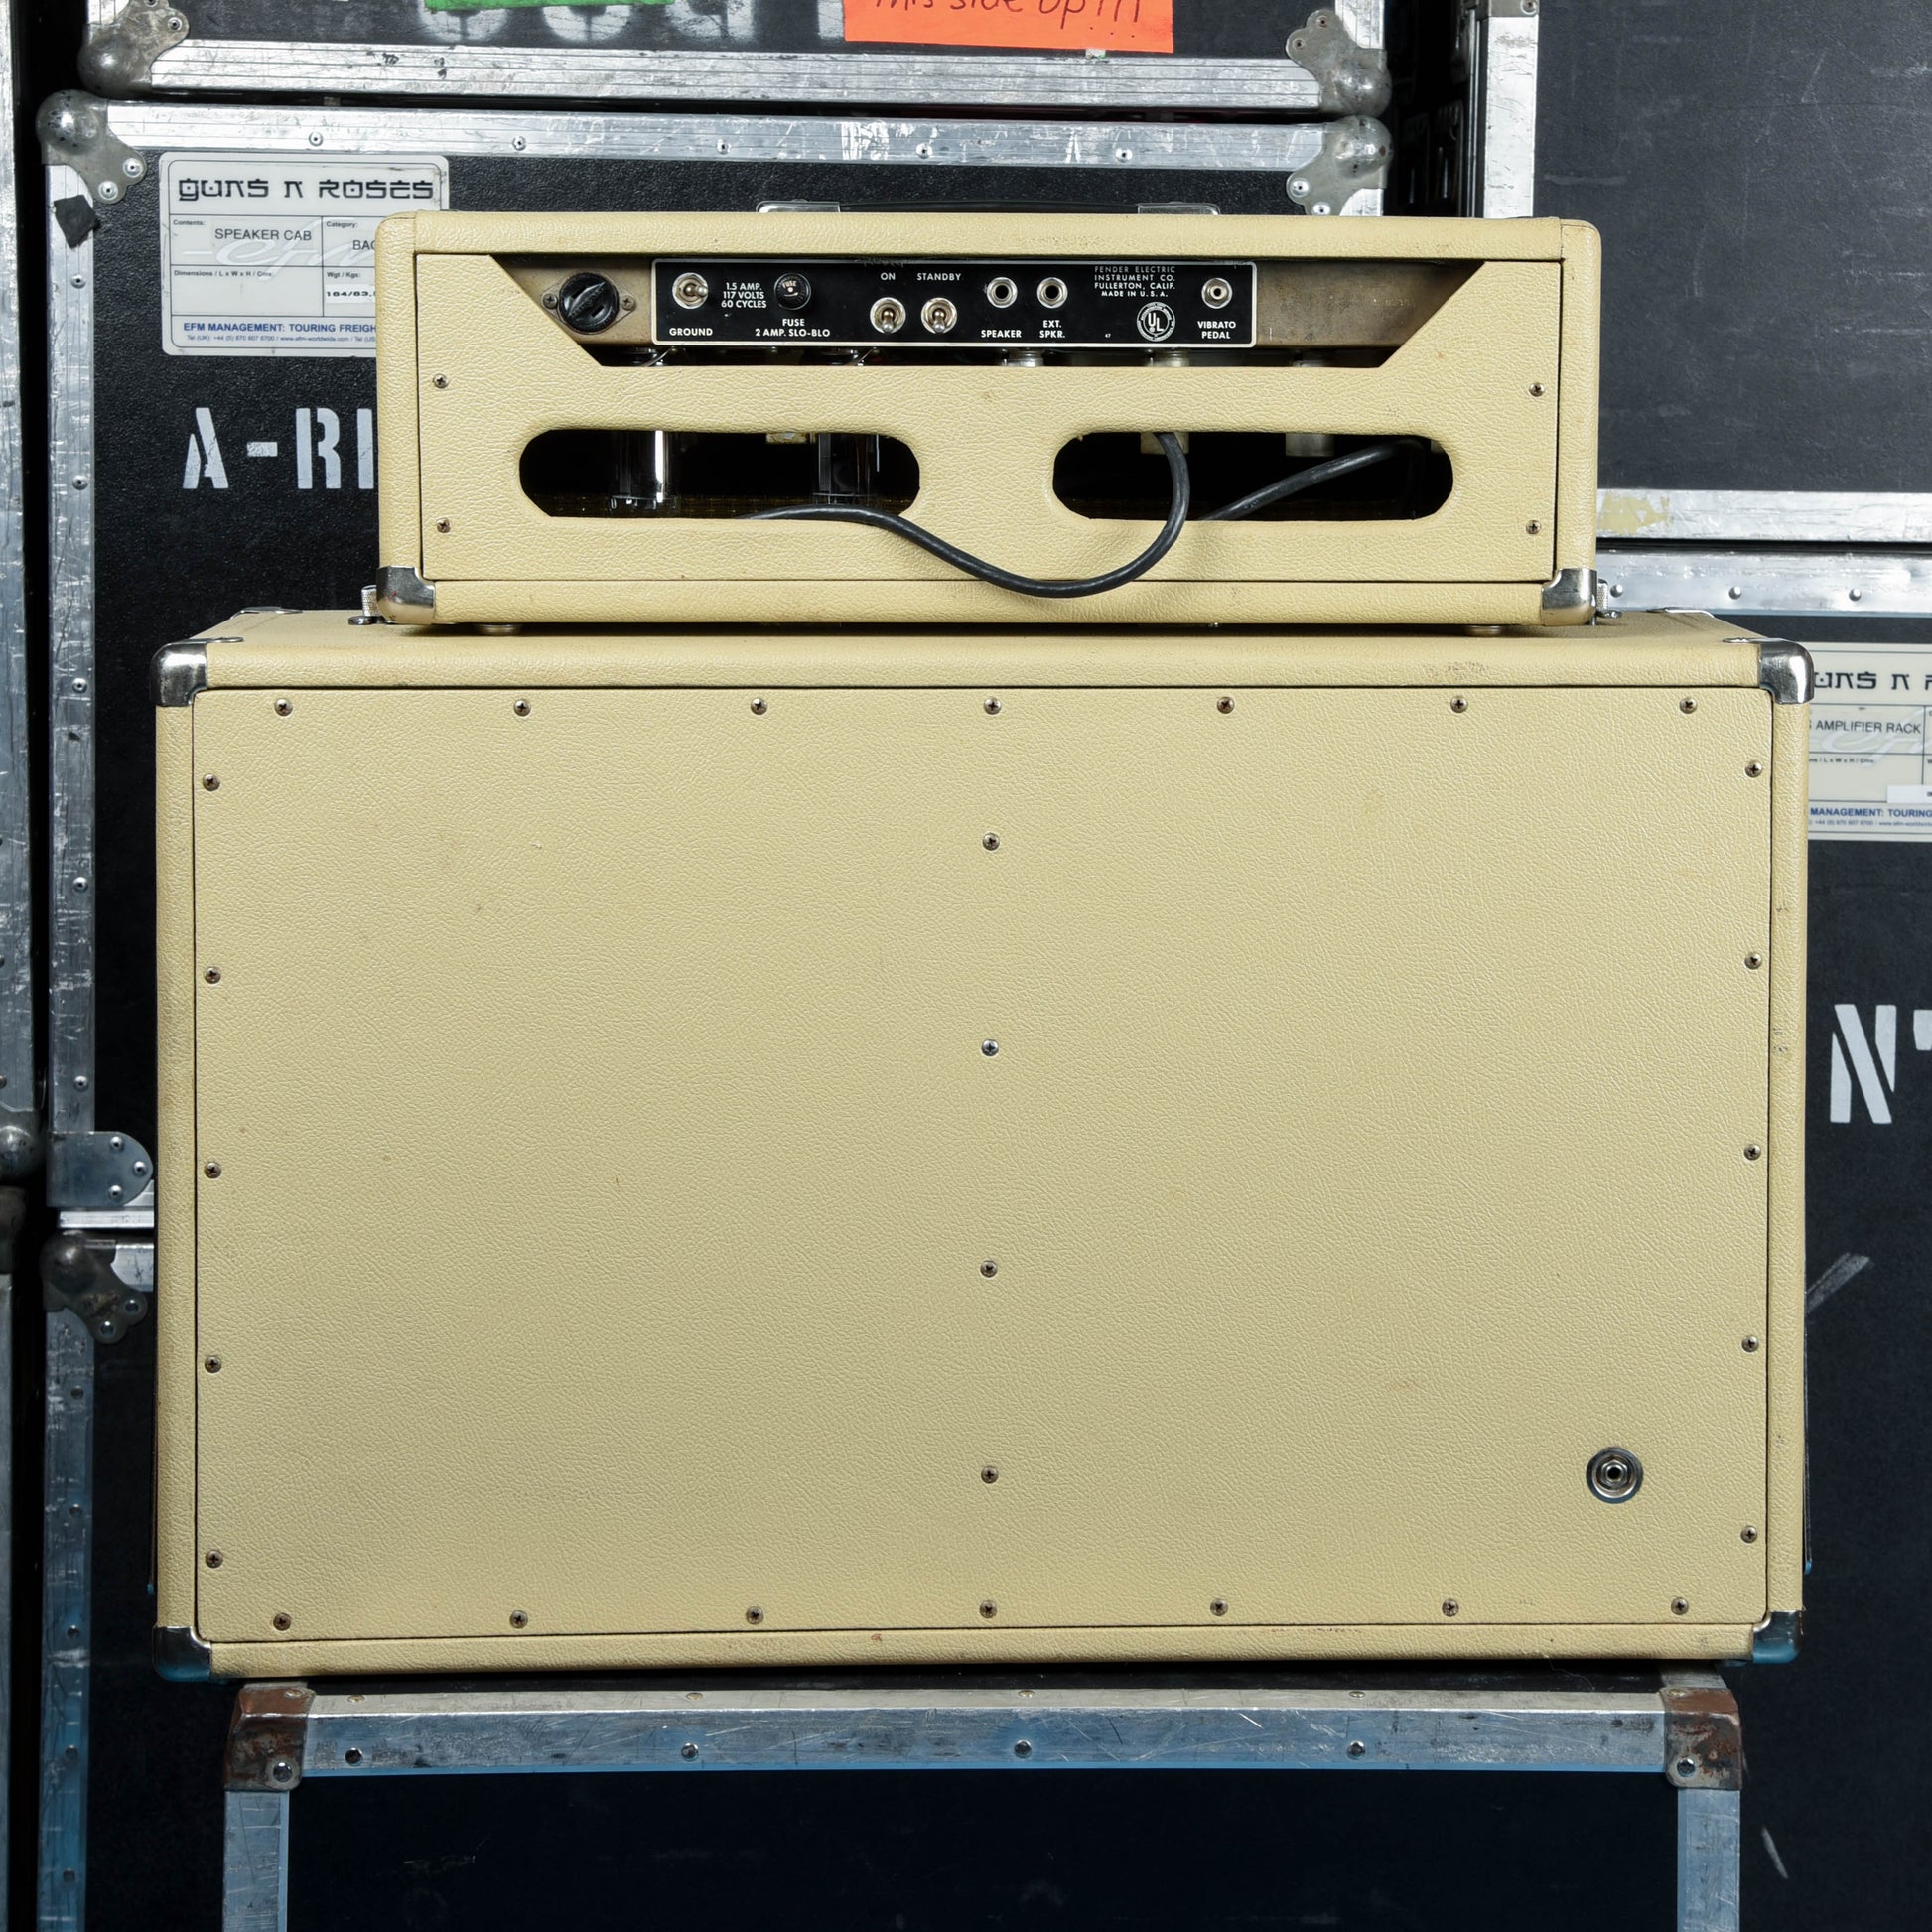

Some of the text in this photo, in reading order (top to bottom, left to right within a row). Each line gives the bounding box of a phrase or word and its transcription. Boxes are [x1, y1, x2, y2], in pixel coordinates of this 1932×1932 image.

[319, 179, 433, 200] ROSES
[326, 221, 358, 230] Category:
[214, 228, 312, 241] SPEAKER CAB
[1133, 266, 1175, 275] ELECTRIC
[880, 272, 961, 282] ON STANDBY
[1094, 274, 1175, 283] INSTRUMENT CO.
[725, 282, 762, 292] 1.5 AMP.
[1094, 282, 1145, 290] FULLERTON,
[723, 291, 765, 300] 117 VOLTS
[721, 300, 767, 309] 60 CYCLES
[782, 319, 805, 328] FUSE
[1042, 320, 1061, 329] EXT.
[1197, 321, 1237, 330] VIBRATO
[183, 323, 376, 334] EFM MANAGEMENT: TOURING FREIGH
[668, 328, 713, 338] GROUND
[755, 329, 830, 339] 2 AMP. SLO-BLO
[980, 329, 1022, 339] SPEAKER
[1039, 330, 1065, 339] SPKR.
[1201, 331, 1231, 340] PEDAL
[1814, 671, 1876, 690] UNS
[1815, 721, 1882, 733] AMPLIFIER
[1886, 723, 1921, 734] RACK
[1810, 807, 1884, 817] MANAGEMENT:
